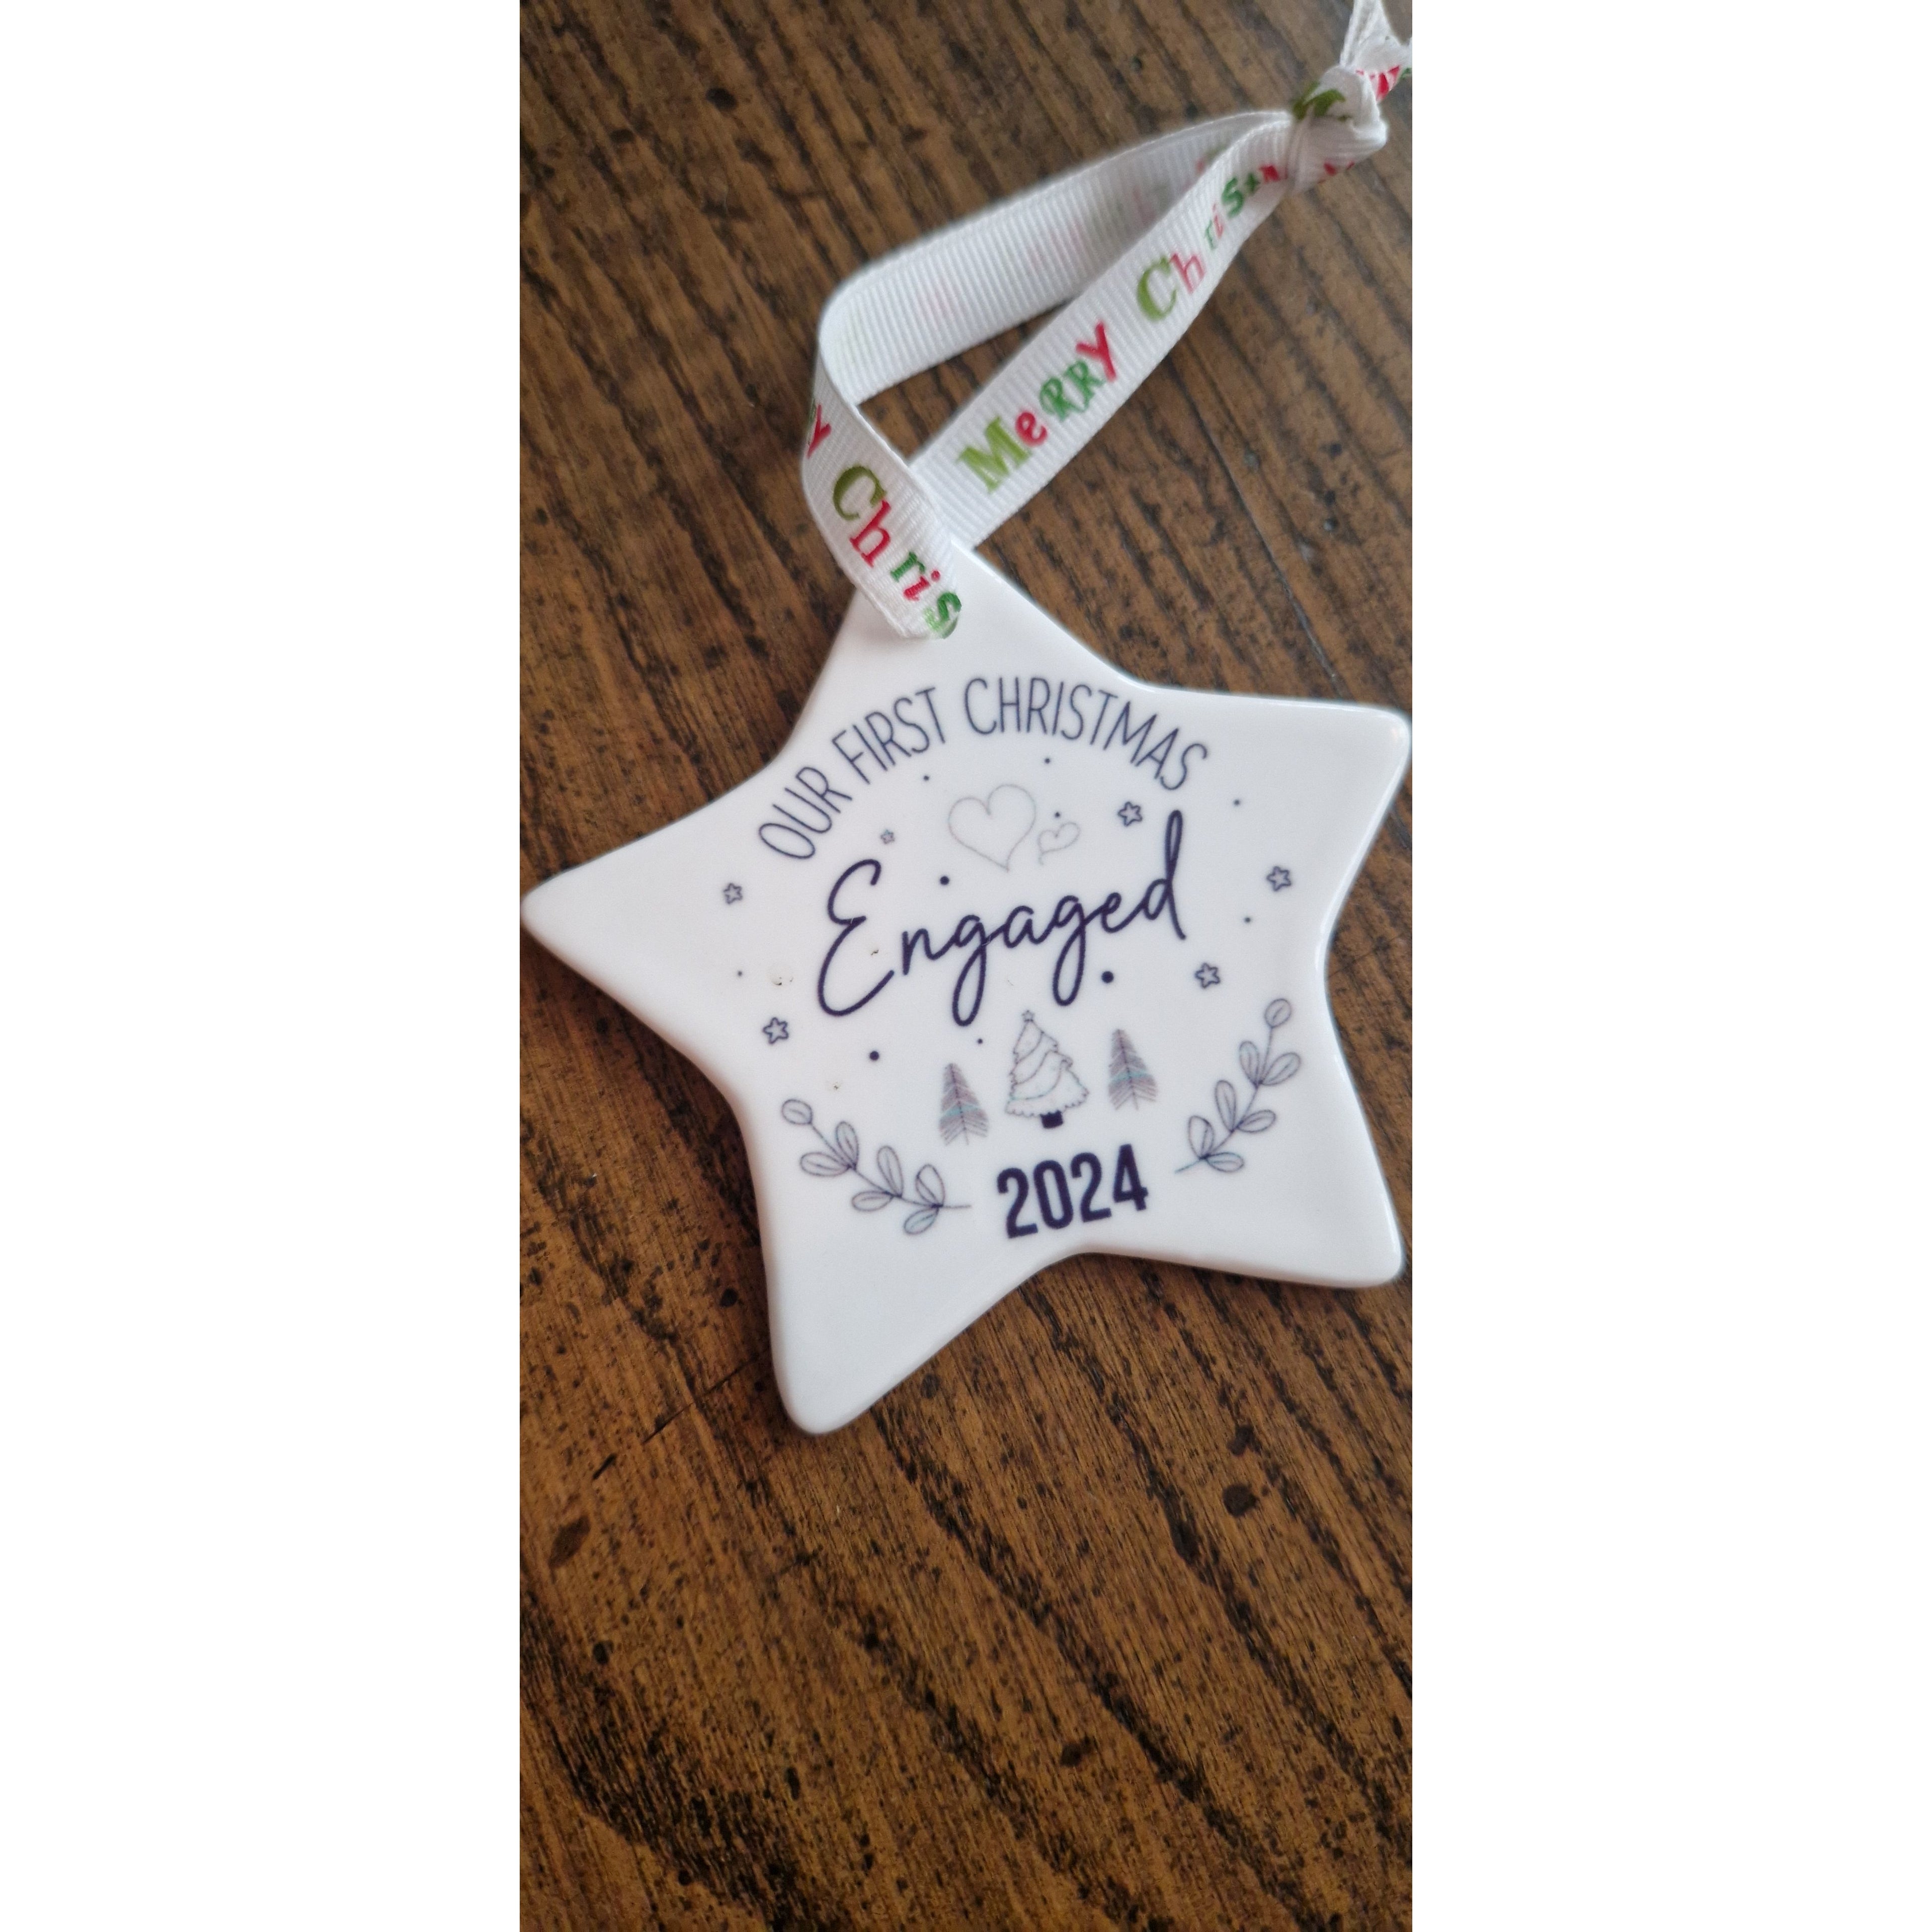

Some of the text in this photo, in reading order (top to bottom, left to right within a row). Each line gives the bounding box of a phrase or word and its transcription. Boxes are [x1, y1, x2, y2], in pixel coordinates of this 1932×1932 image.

[758, 676, 1209, 860] OUR FIRST CHRISTMAS
[816, 809, 1187, 1028] Engaged
[996, 1143, 1149, 1240] 2024
